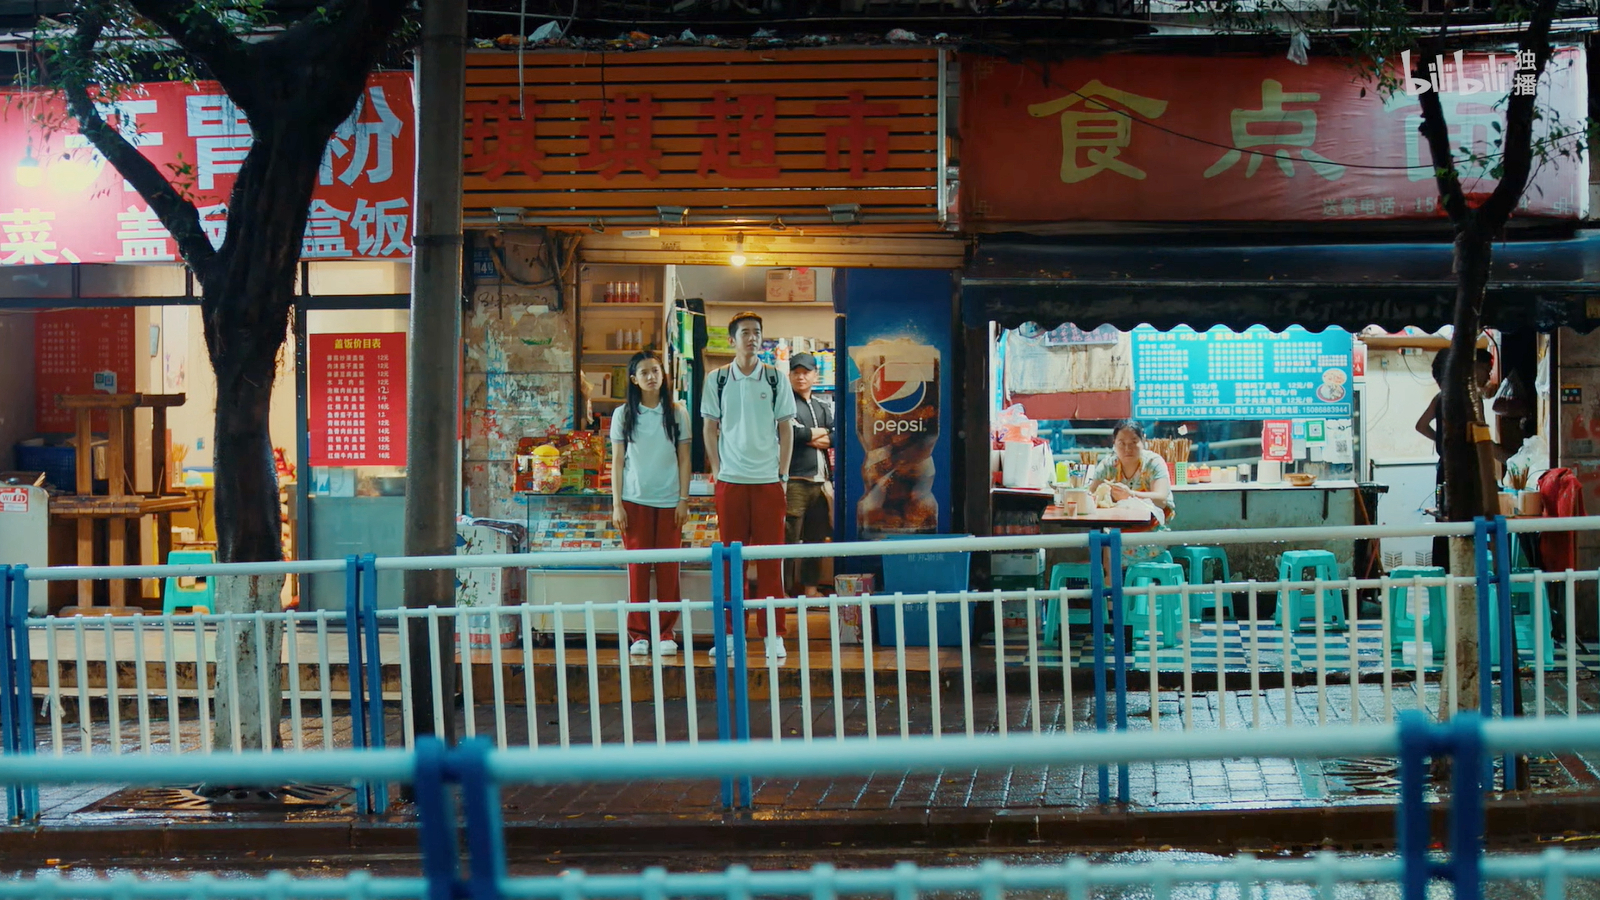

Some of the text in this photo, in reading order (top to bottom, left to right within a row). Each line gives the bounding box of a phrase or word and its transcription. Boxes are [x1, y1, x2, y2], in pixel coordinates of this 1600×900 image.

[463, 90, 898, 182] 琪琪超市
[334, 338, 382, 349] 盖饭价目表
[873, 417, 924, 435] pepsi
